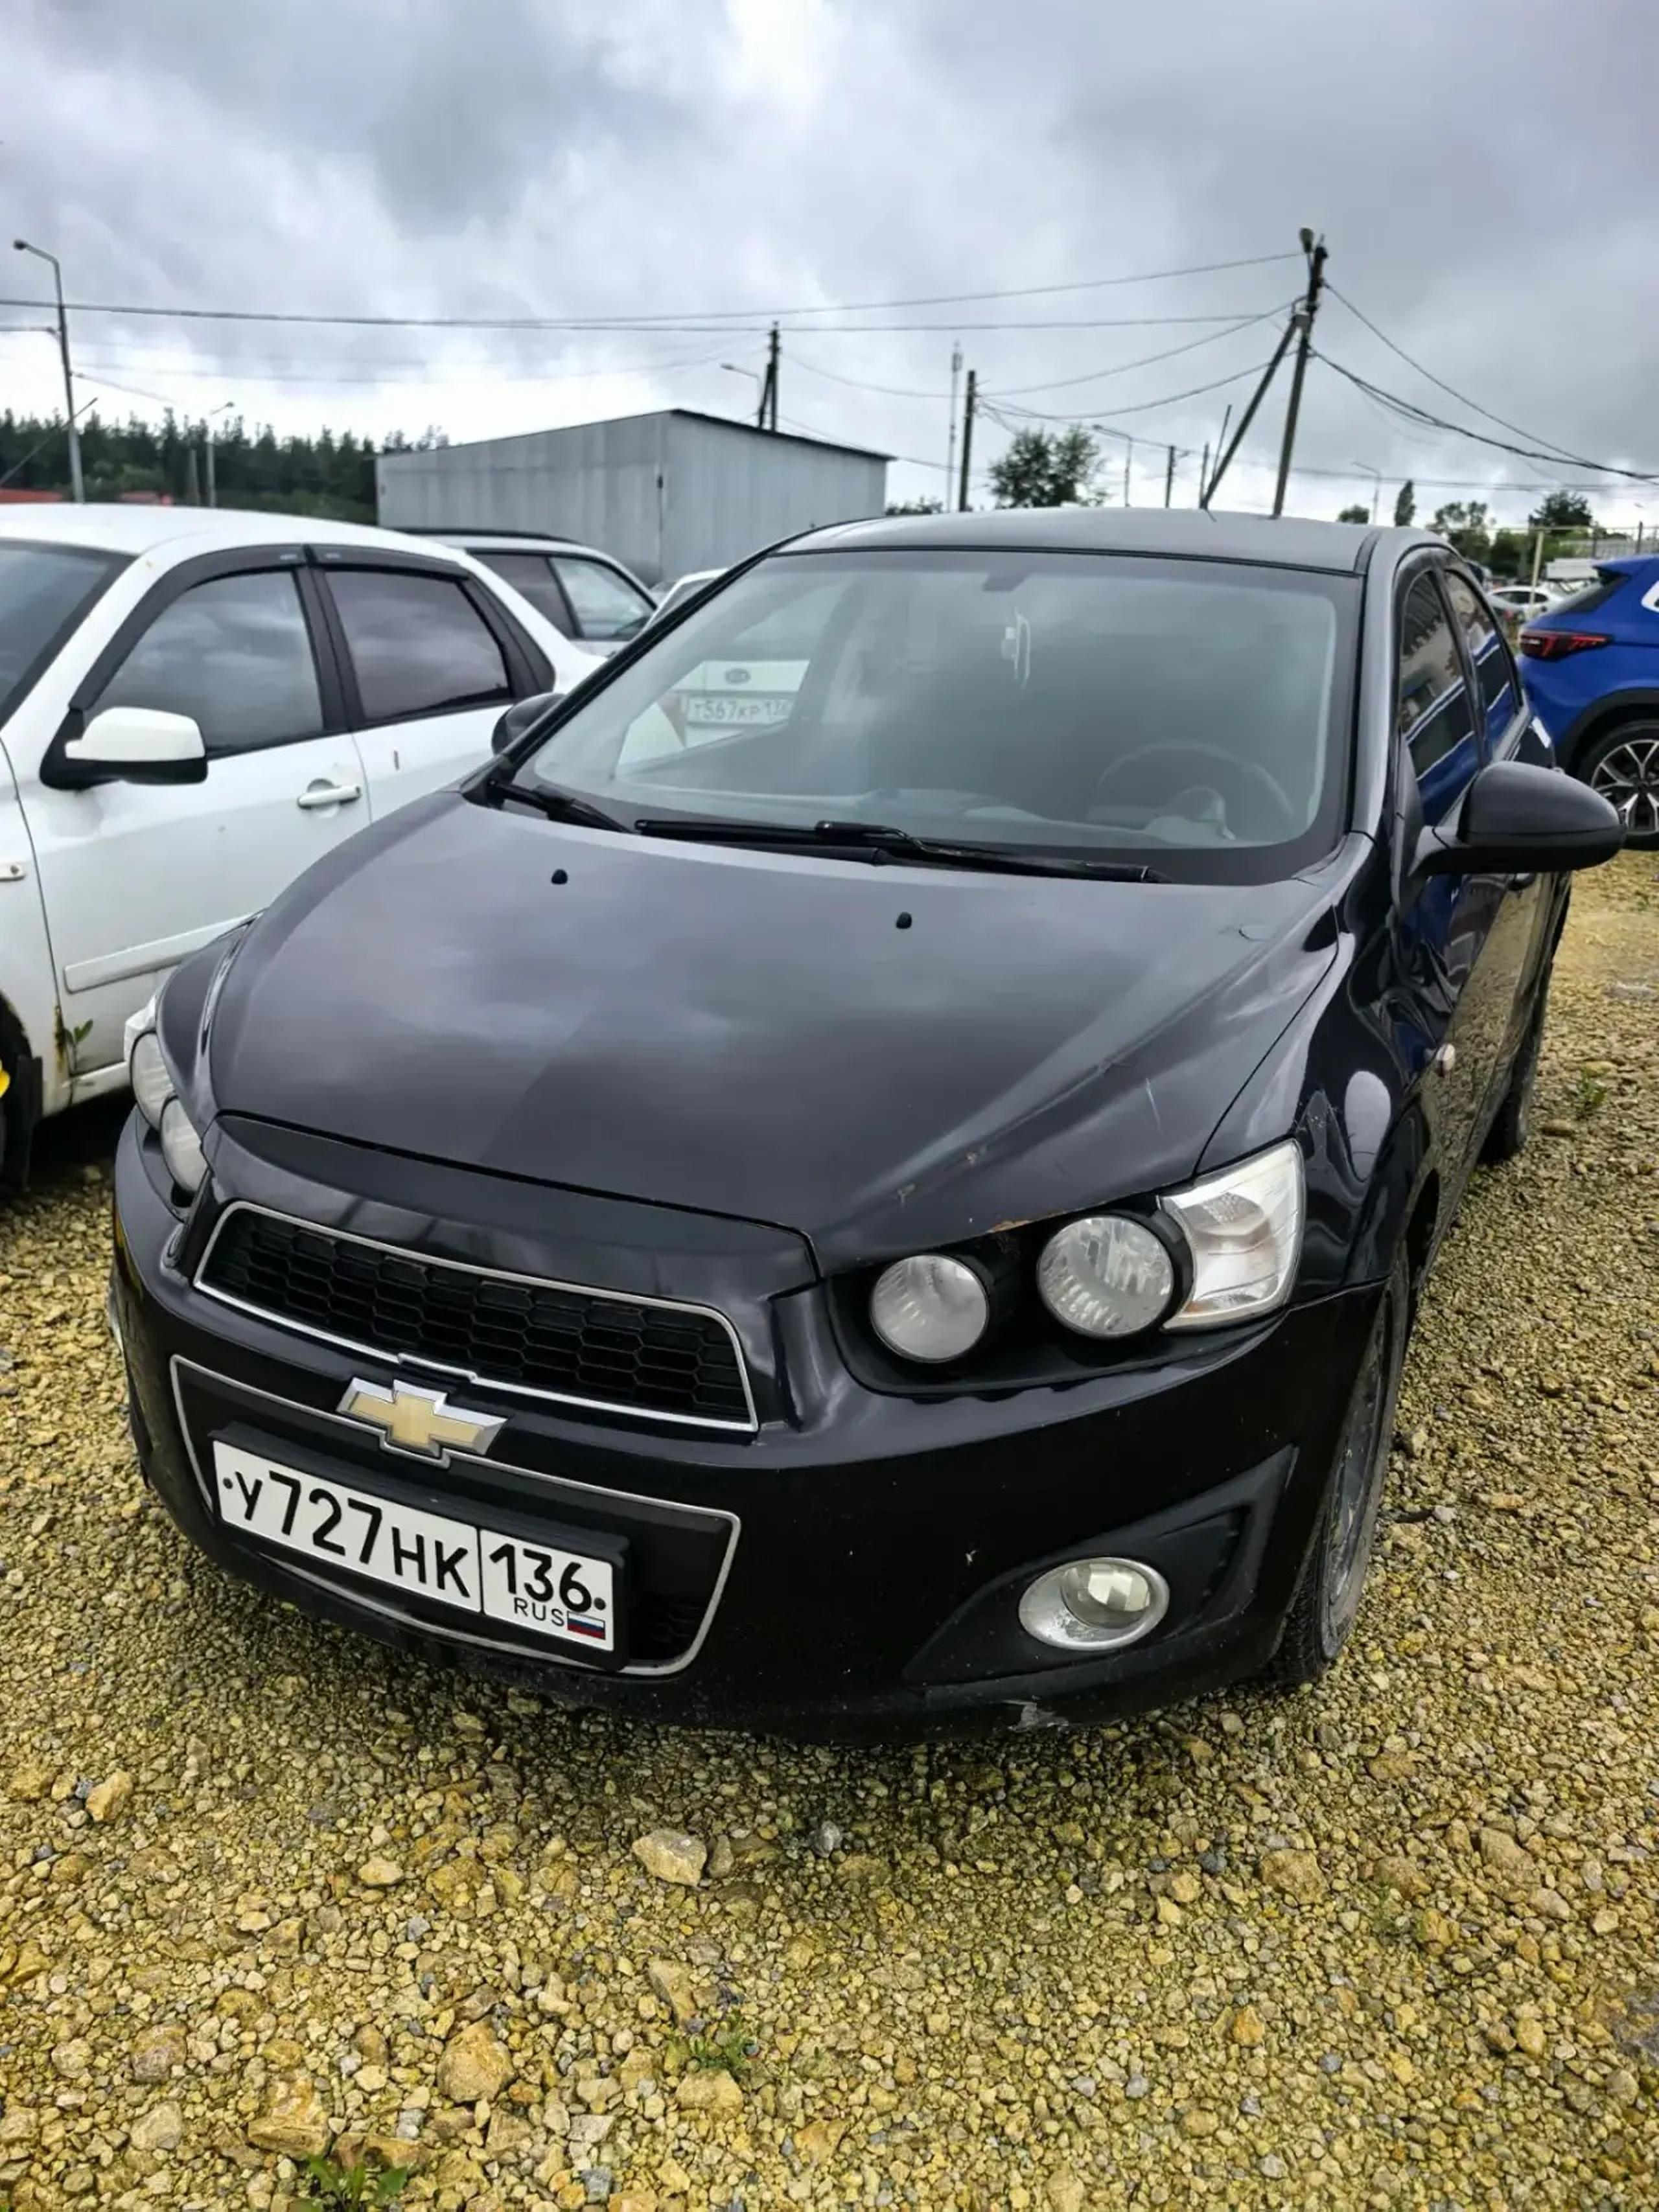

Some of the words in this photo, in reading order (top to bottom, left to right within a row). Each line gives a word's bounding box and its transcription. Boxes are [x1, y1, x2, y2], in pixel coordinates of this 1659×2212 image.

[235, 1470, 470, 1598] У727НК
[489, 1543, 592, 1613] 136
[514, 1598, 564, 1628] RUS
